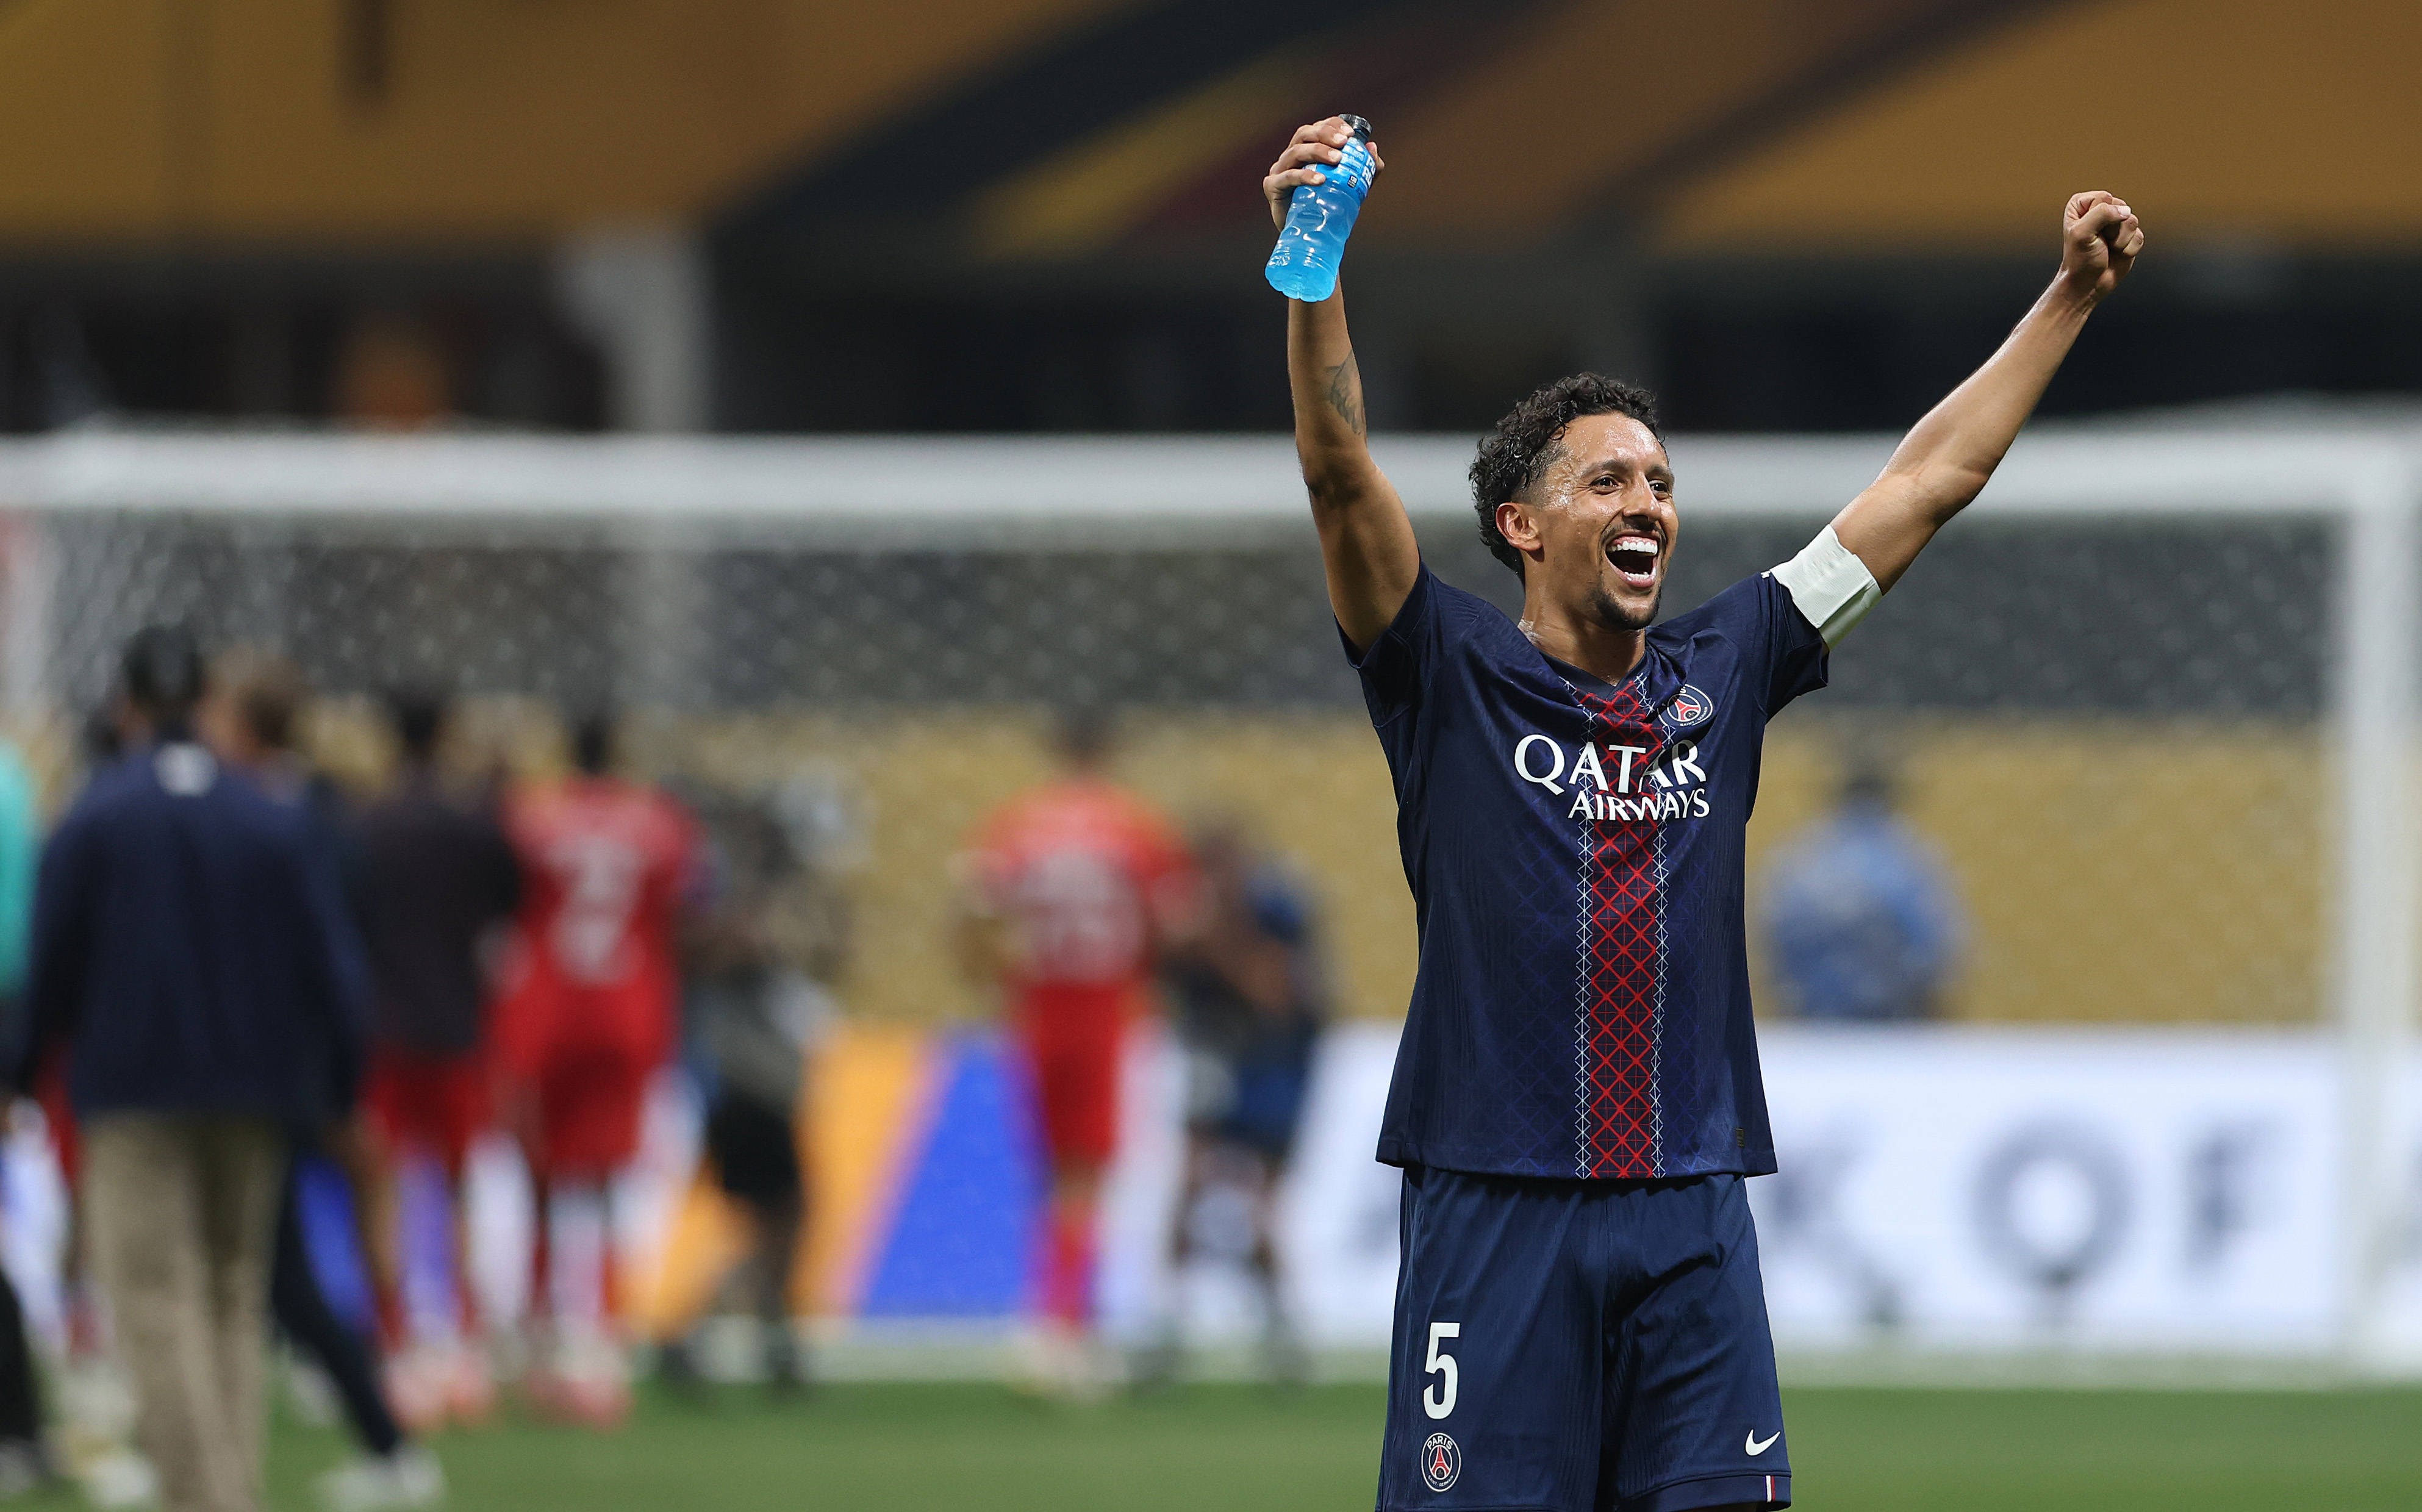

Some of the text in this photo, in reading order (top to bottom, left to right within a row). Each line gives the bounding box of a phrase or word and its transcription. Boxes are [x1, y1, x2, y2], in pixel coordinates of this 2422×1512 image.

[1514, 734, 1707, 795] QATAR
[1567, 788, 1710, 821] AIRWAYS
[1424, 1322, 1460, 1419] 5
[1427, 1436, 1453, 1450] PARIS
